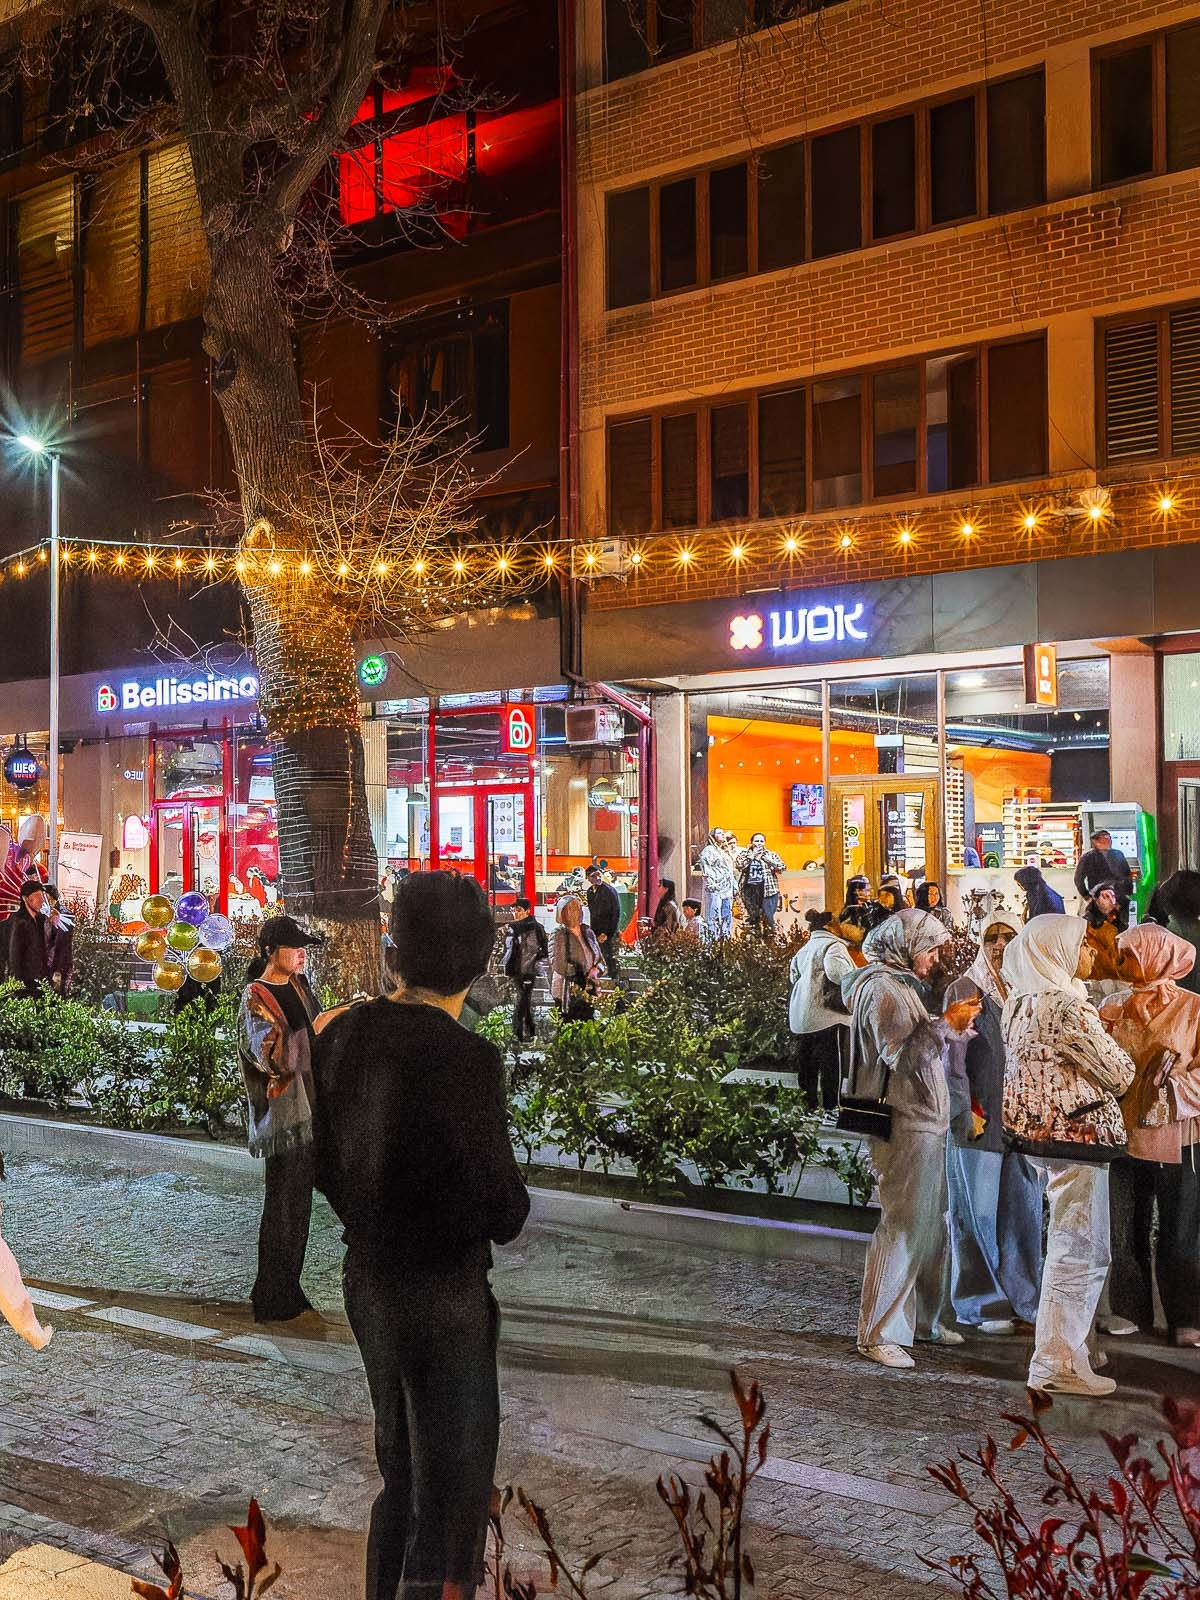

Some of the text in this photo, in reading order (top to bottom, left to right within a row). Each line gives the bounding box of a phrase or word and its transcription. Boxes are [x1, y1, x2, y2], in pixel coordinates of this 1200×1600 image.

[771, 603, 868, 647] WOK
[122, 674, 258, 709] Bellissimo
[13, 763, 36, 773] ШЕФ
